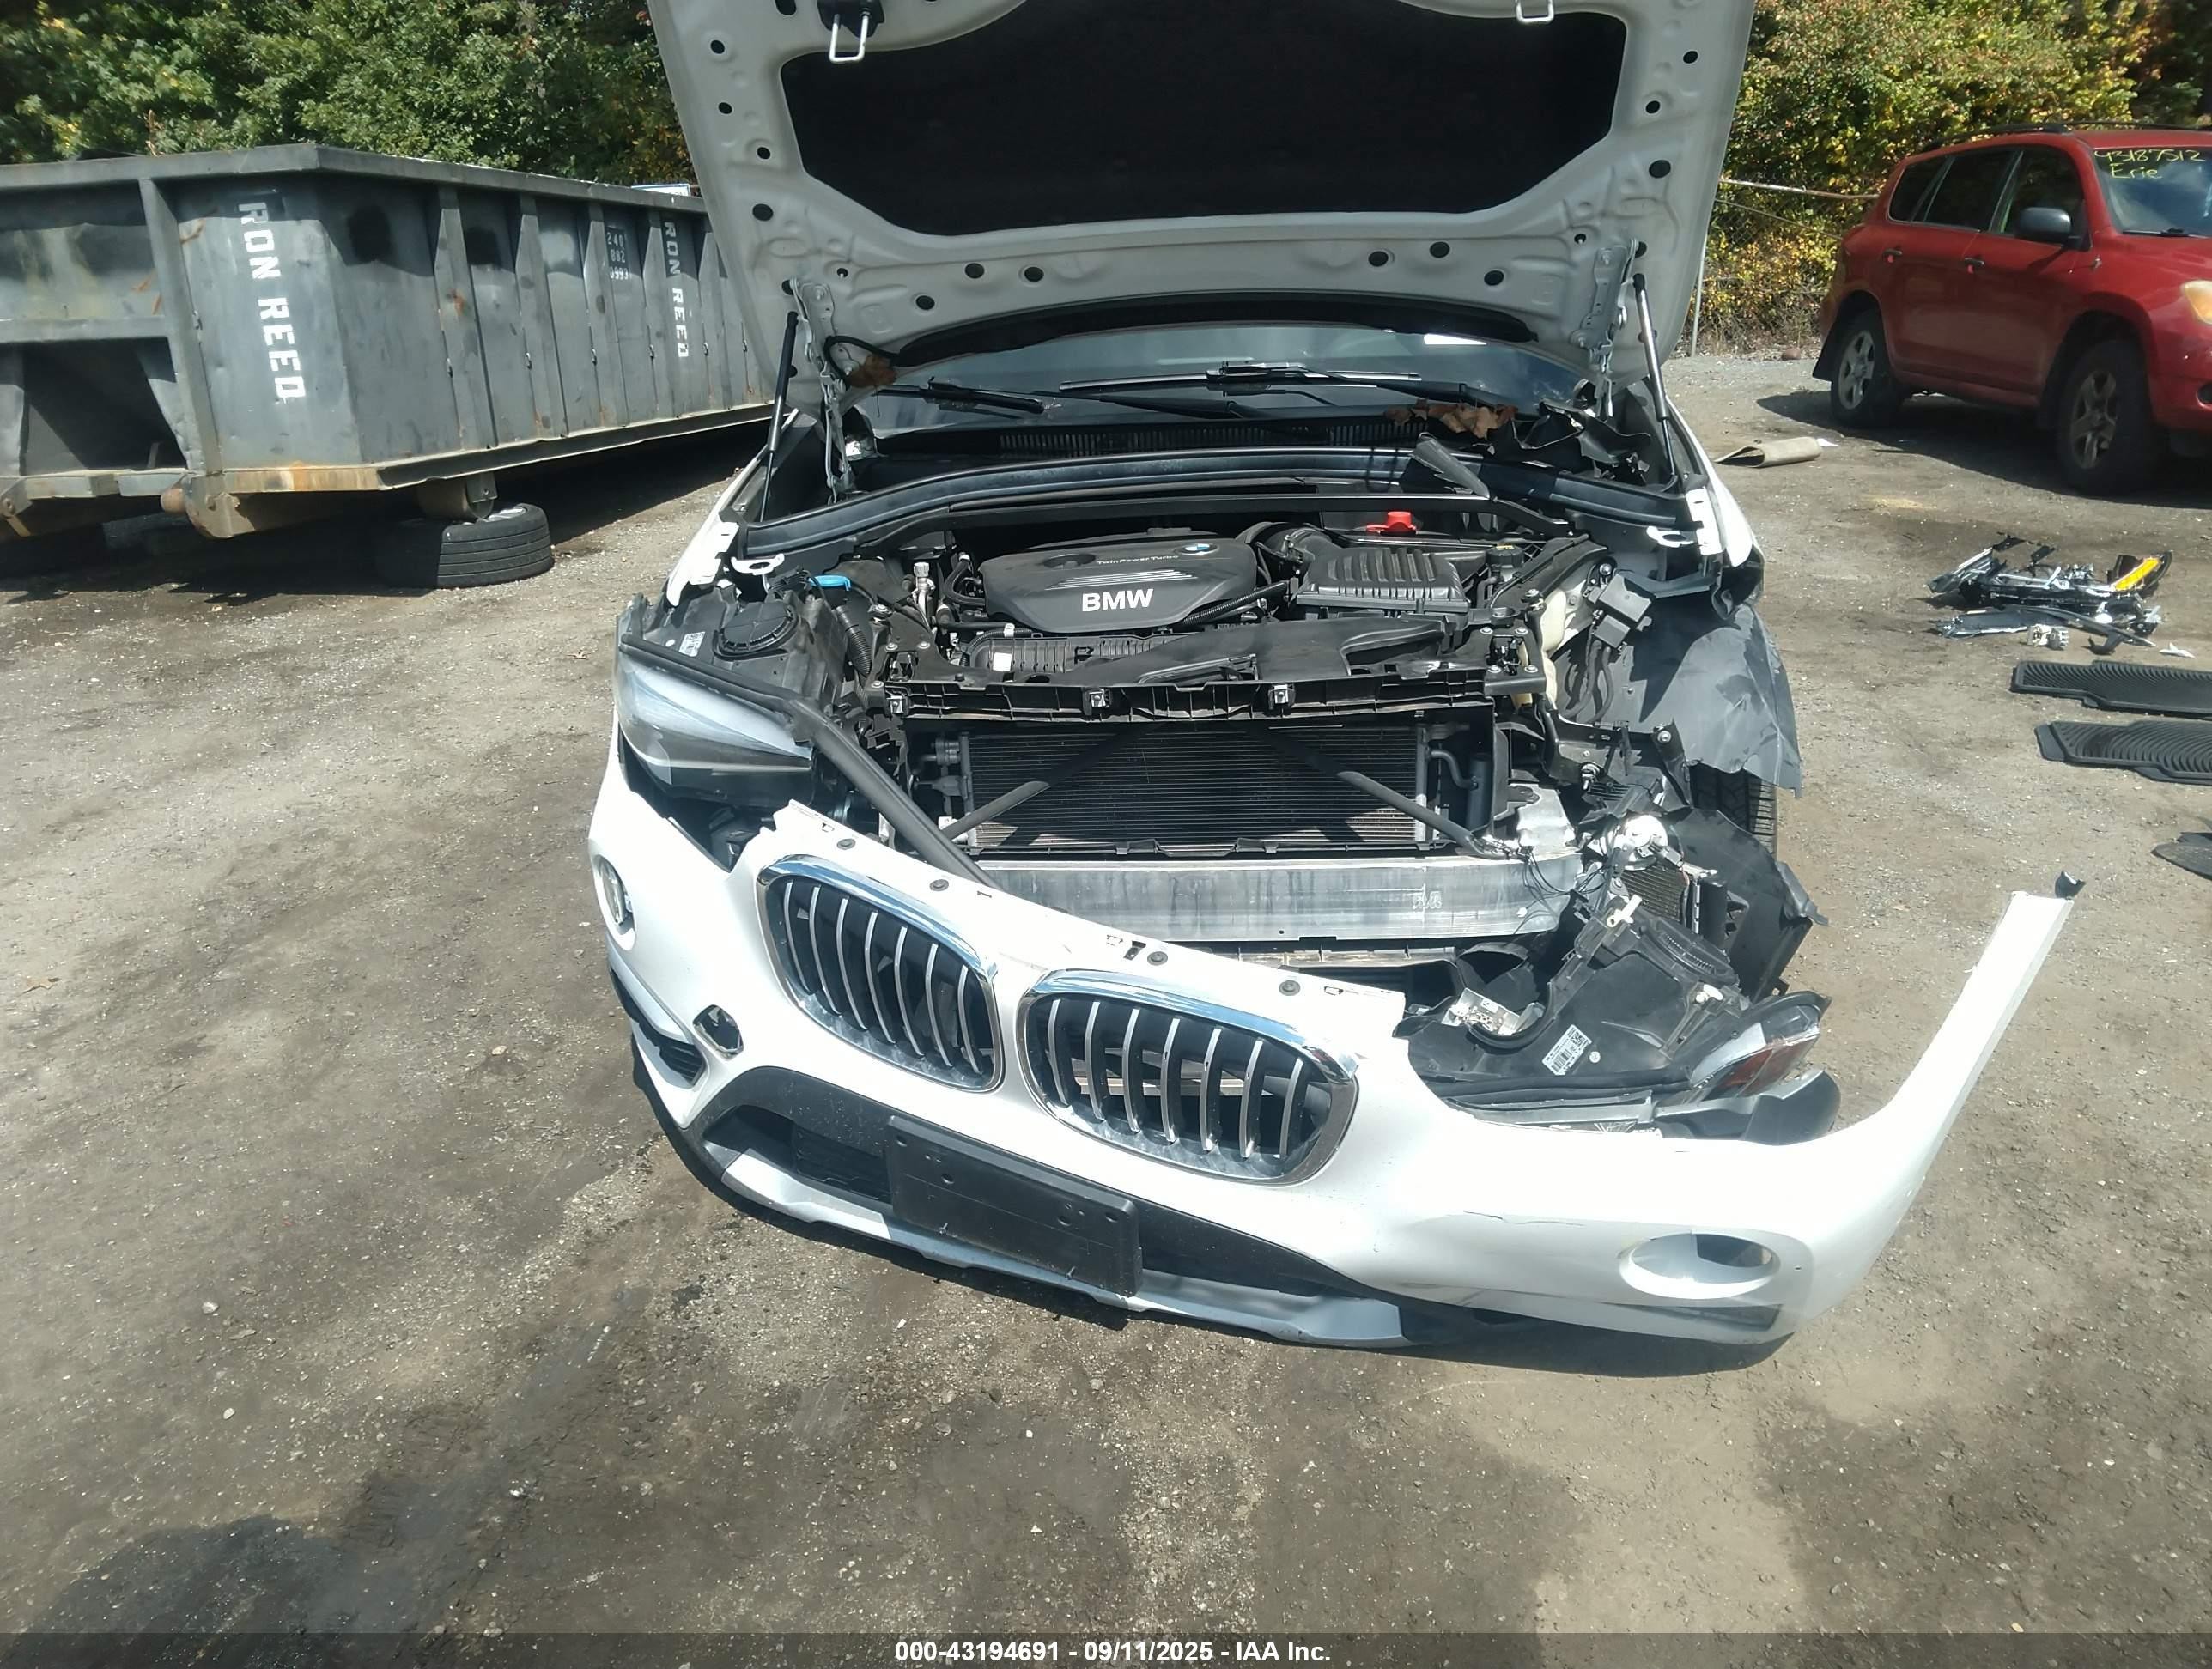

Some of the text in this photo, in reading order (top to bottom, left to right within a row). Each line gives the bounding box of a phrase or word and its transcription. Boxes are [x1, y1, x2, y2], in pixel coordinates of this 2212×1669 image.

[2094, 149, 2207, 162] 43187512
[2109, 162, 2163, 179] Erie
[238, 202, 307, 399] RON REED
[664, 222, 690, 358] RON REED
[1082, 588, 1154, 612] BMW
